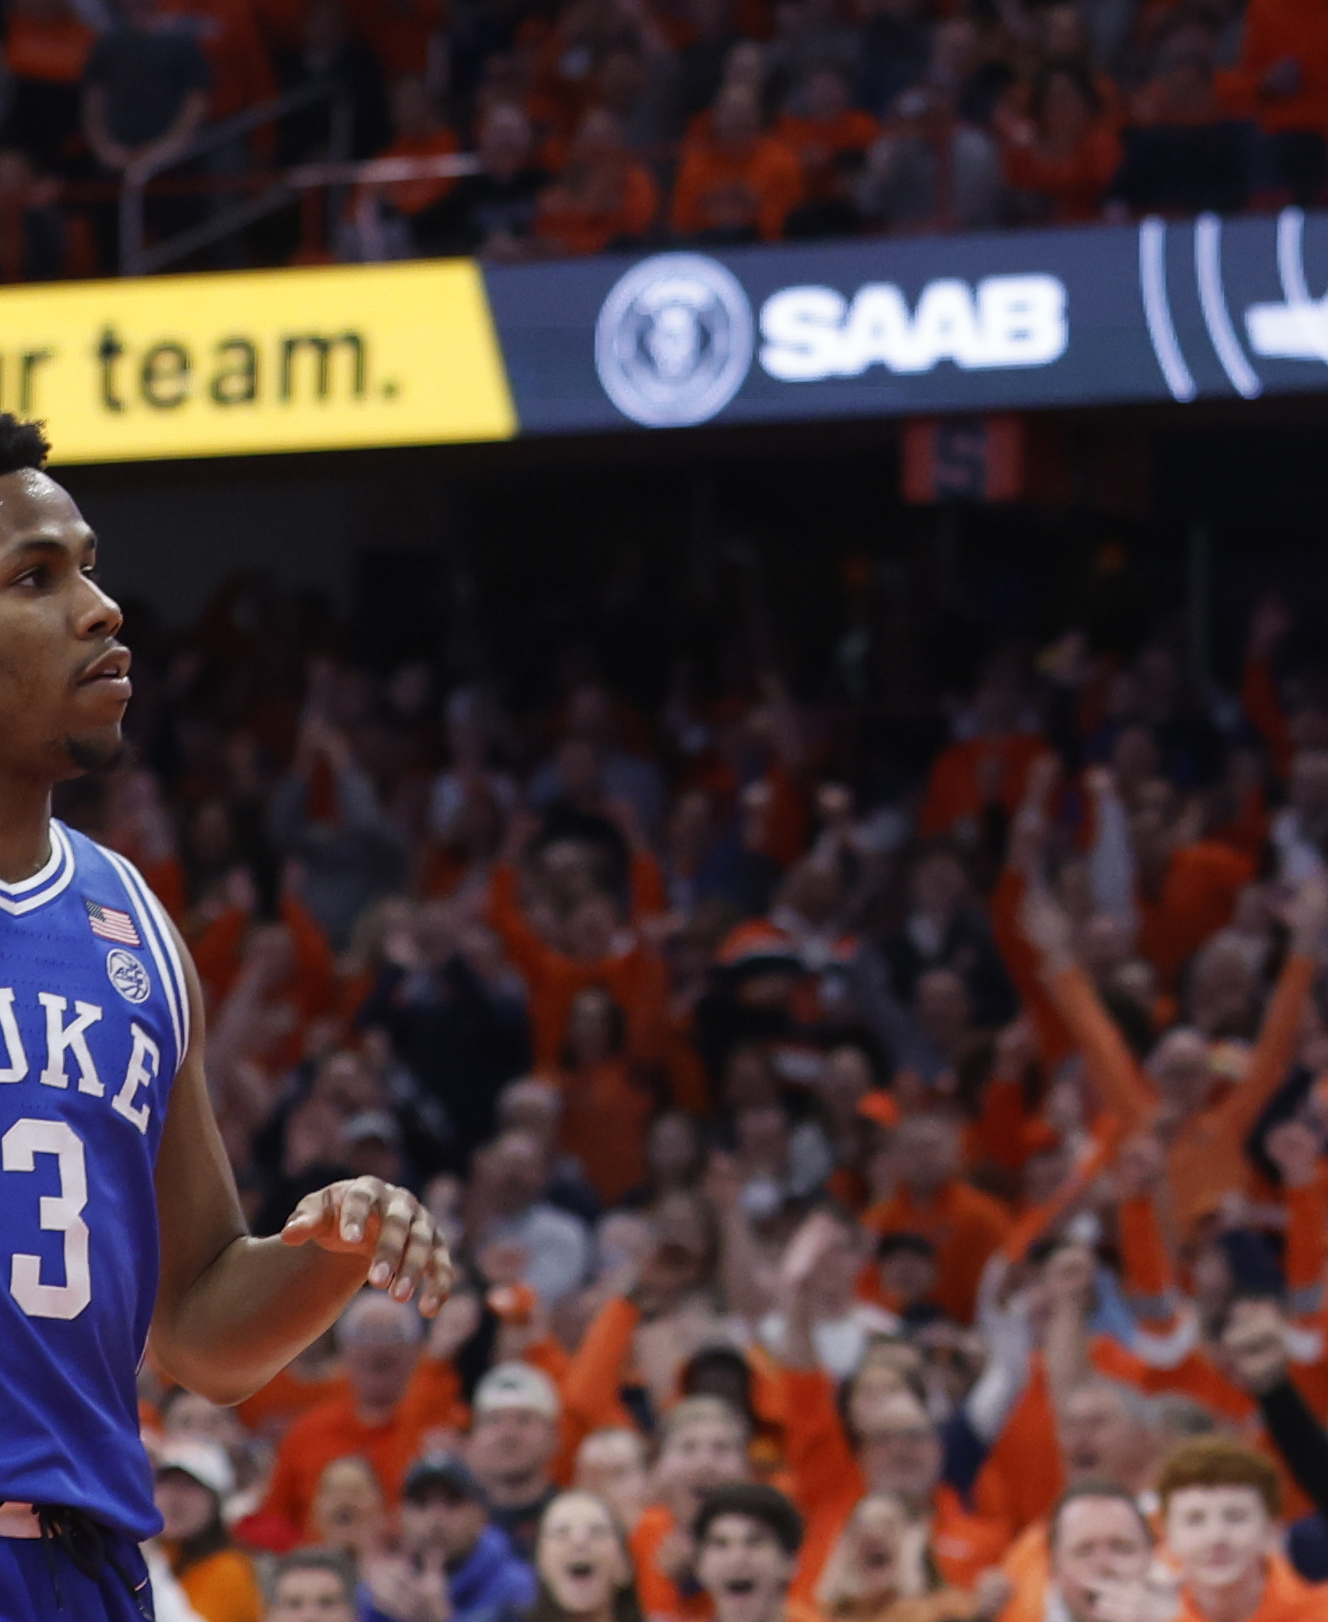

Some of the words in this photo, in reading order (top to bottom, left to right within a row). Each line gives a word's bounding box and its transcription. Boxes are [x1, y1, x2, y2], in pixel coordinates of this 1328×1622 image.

[93, 324, 399, 416] team.
[760, 276, 1067, 381] SAAB
[1, 1118, 91, 1320] 3
